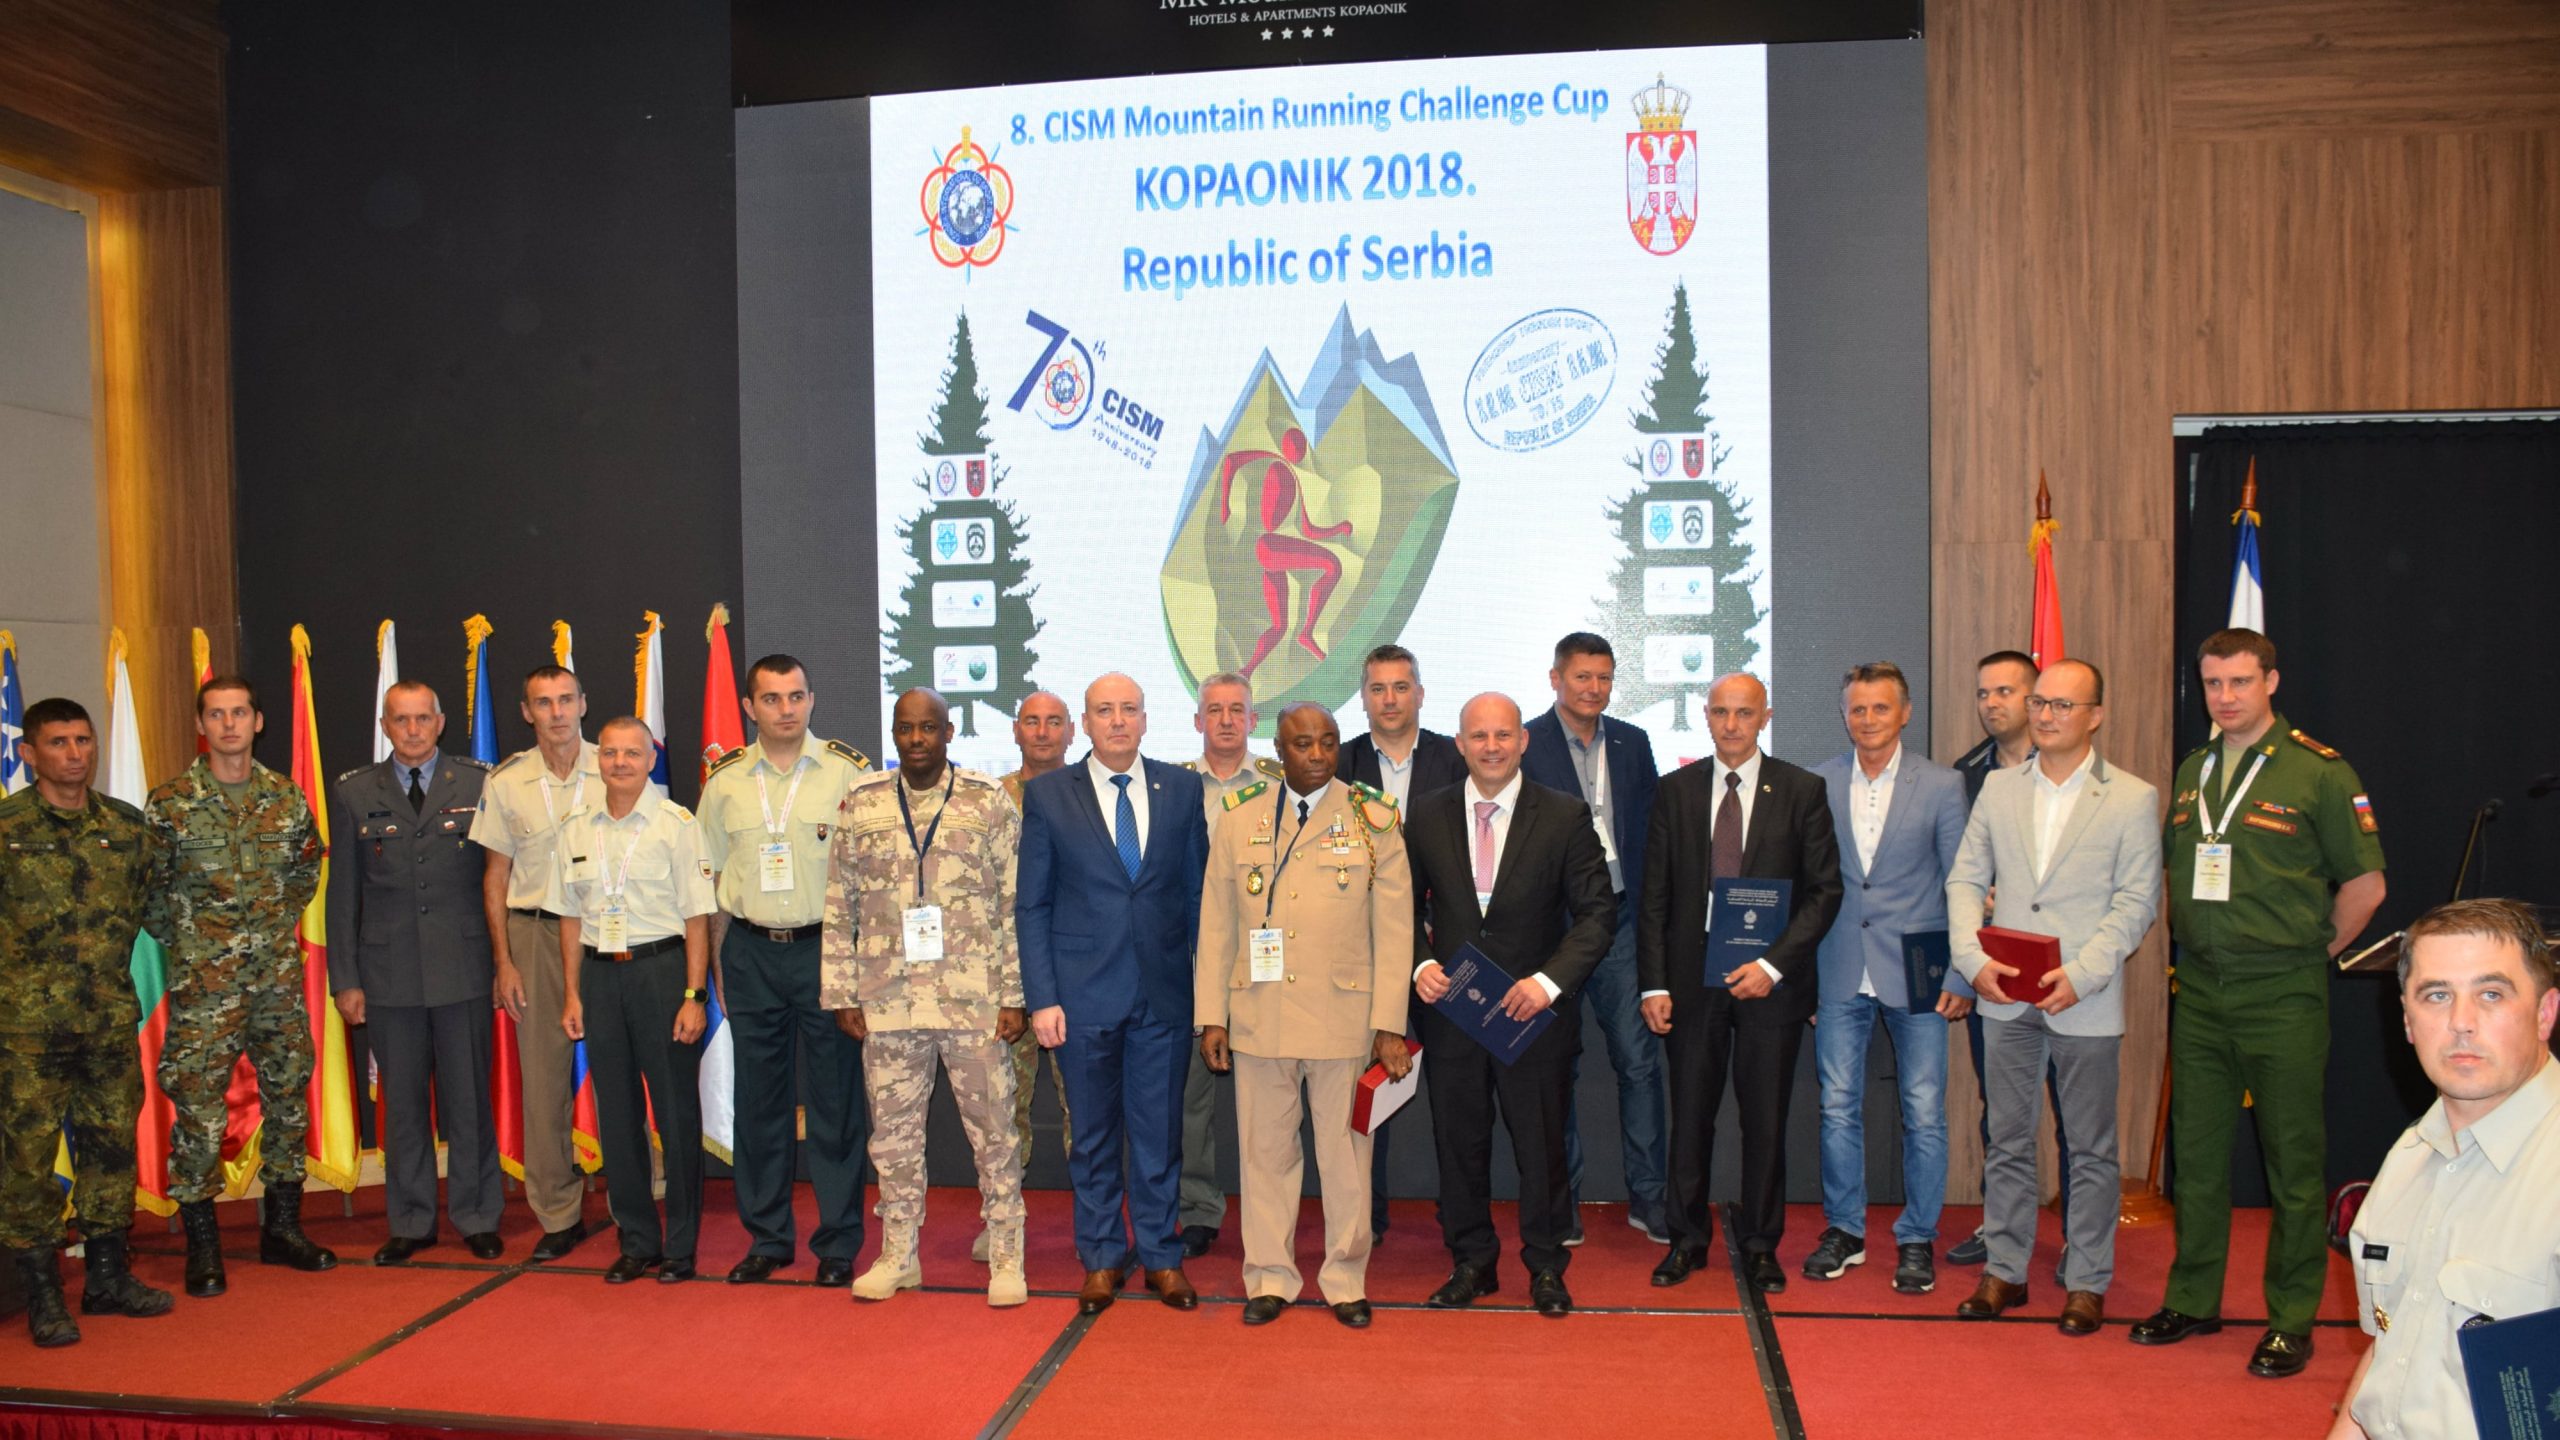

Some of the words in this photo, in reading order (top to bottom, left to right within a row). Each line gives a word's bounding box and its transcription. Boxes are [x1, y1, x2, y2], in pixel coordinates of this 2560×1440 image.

[1189, 13, 1237, 26] HOTELS
[1240, 12, 1250, 23] &
[1254, 7, 1336, 22] APARTMENTS
[1340, 2, 1408, 17] KOPAONIK
[1010, 113, 1035, 146] 8.
[1044, 107, 1116, 142] CISM
[1124, 98, 1264, 138] Mountain
[1272, 91, 1391, 132] Running
[1400, 83, 1544, 126] Challenge
[1553, 82, 1609, 123] Cup
[1135, 156, 1352, 212] KOPAONIK
[1362, 151, 1477, 201] 2018.
[1123, 237, 1299, 301] Republic
[1308, 233, 1352, 284] of
[1362, 229, 1493, 283] Serbia
[1102, 388, 1164, 441] CISM
